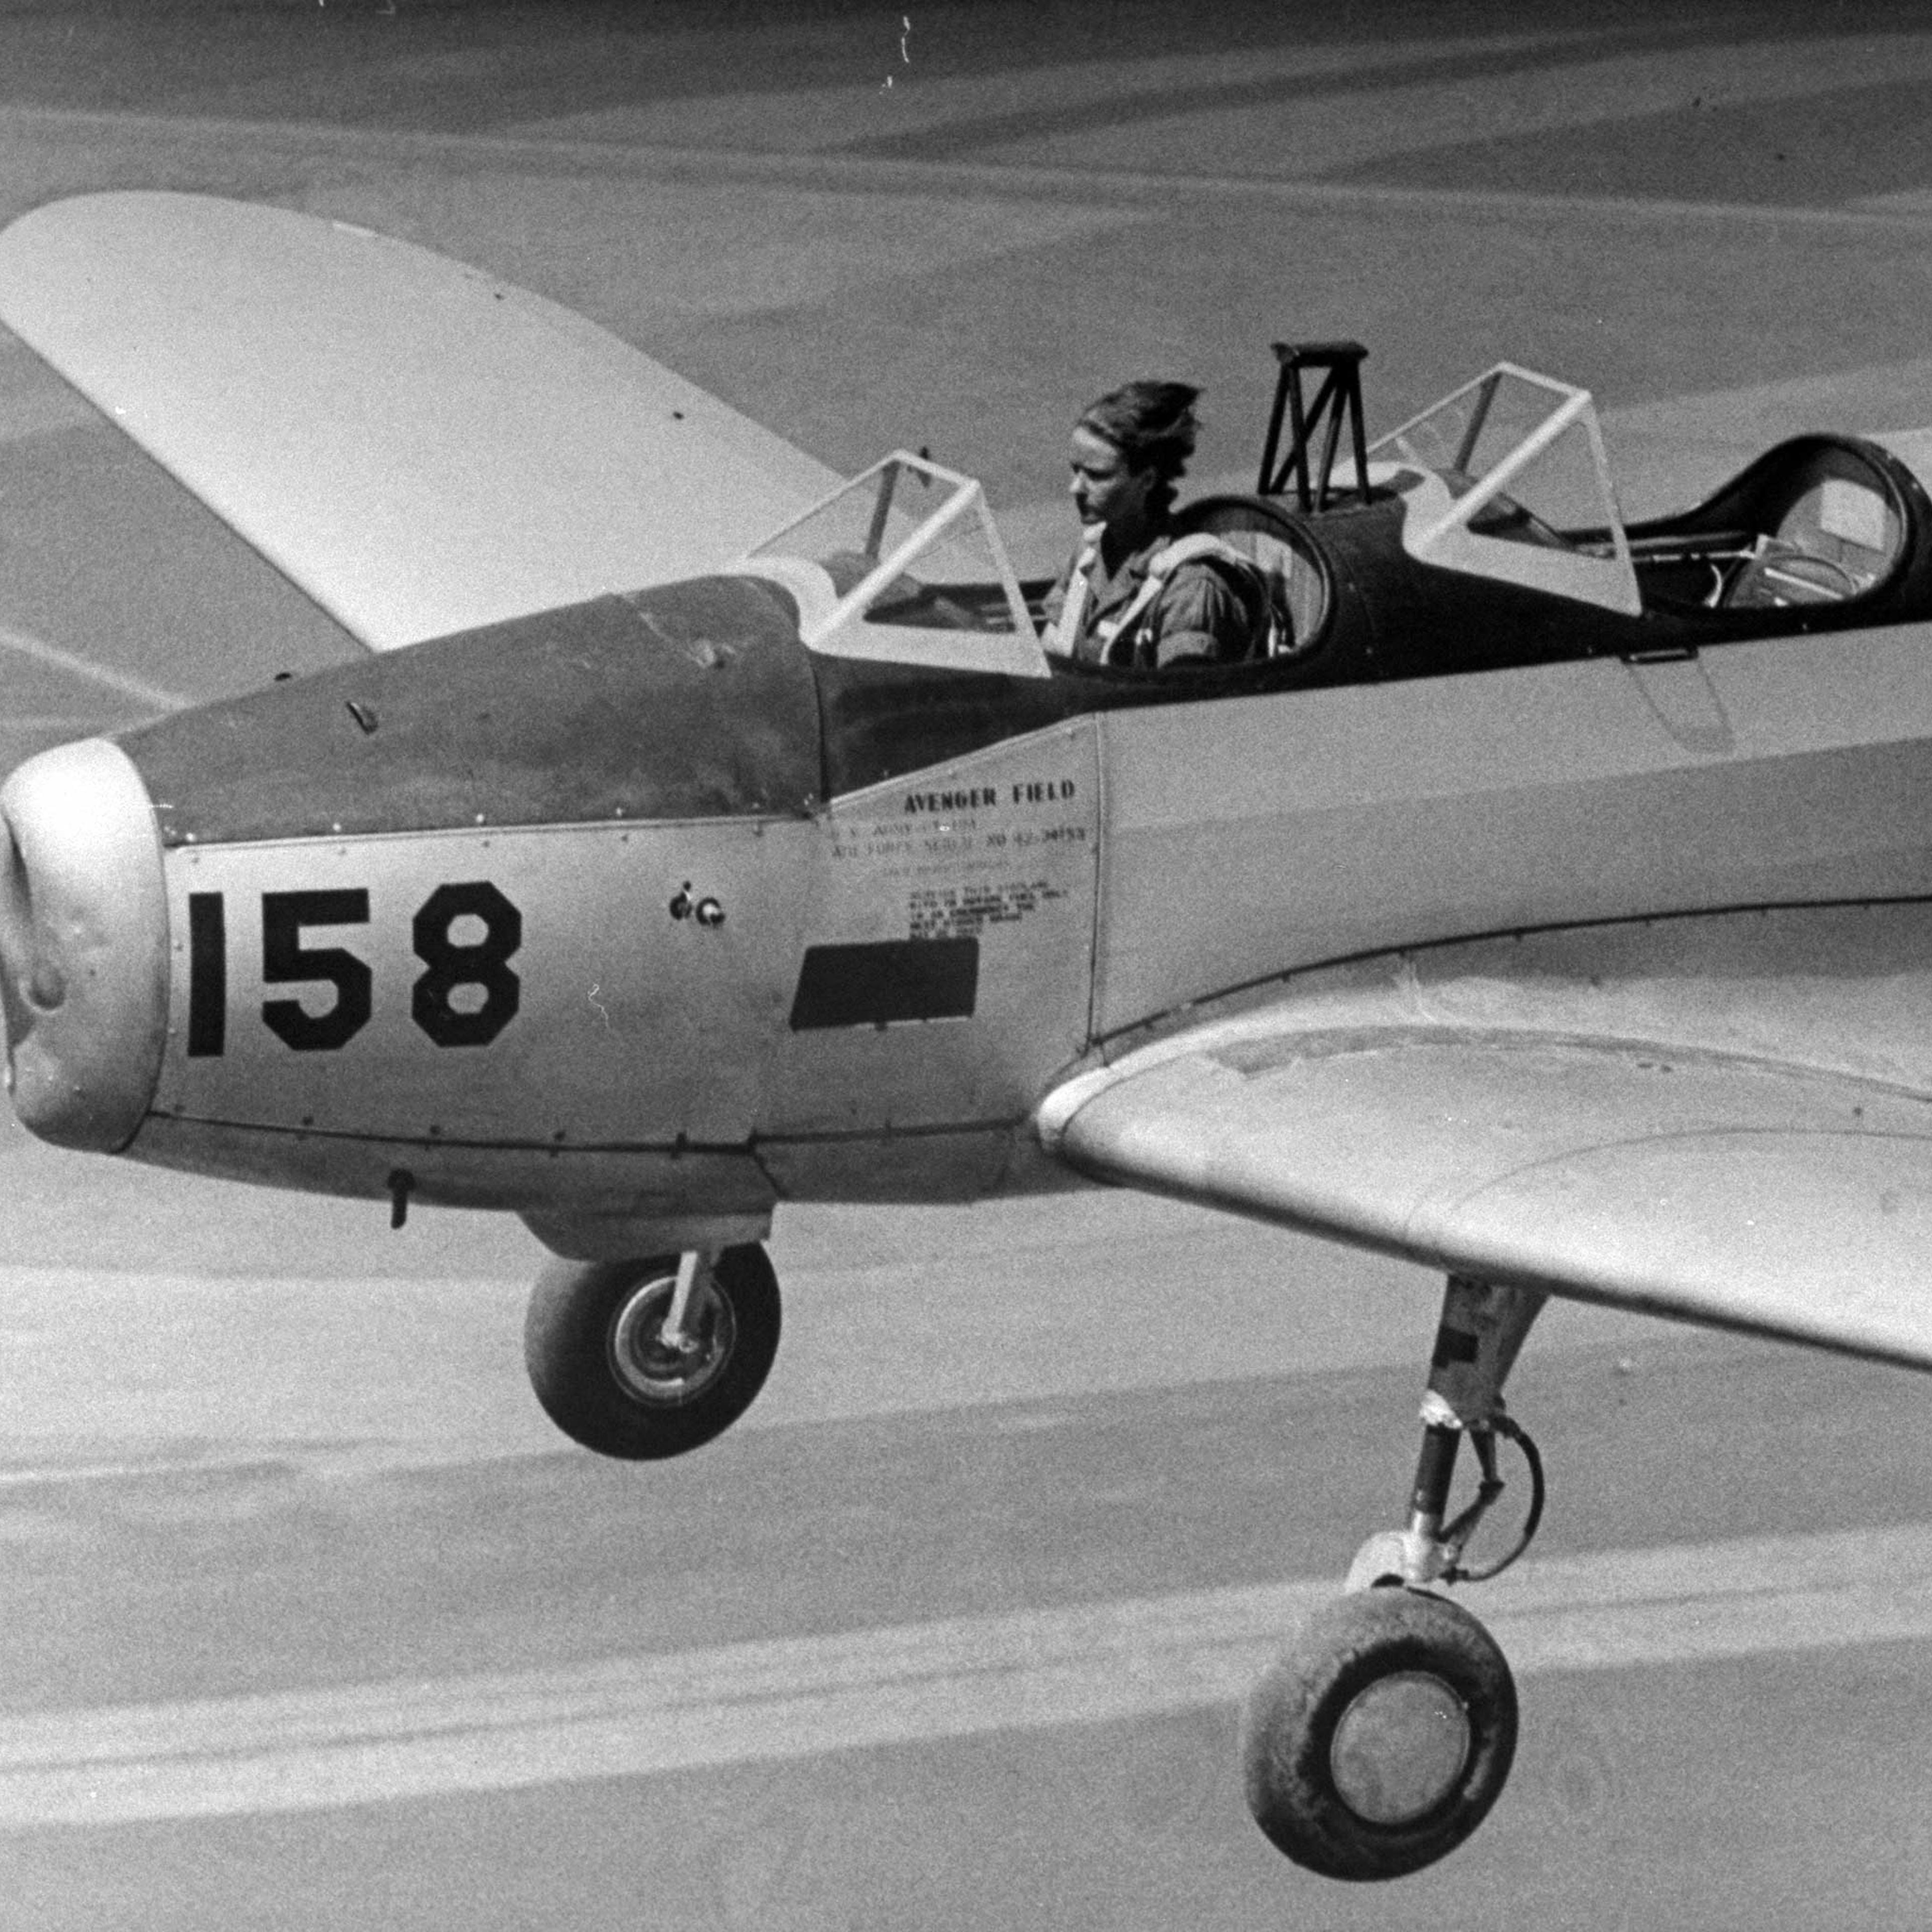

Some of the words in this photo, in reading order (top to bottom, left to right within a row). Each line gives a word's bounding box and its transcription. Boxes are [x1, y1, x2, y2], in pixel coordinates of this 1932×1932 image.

[904, 787, 996, 813] AVENGER
[1012, 779, 1075, 804] FIELD
[188, 881, 522, 1057] 158
